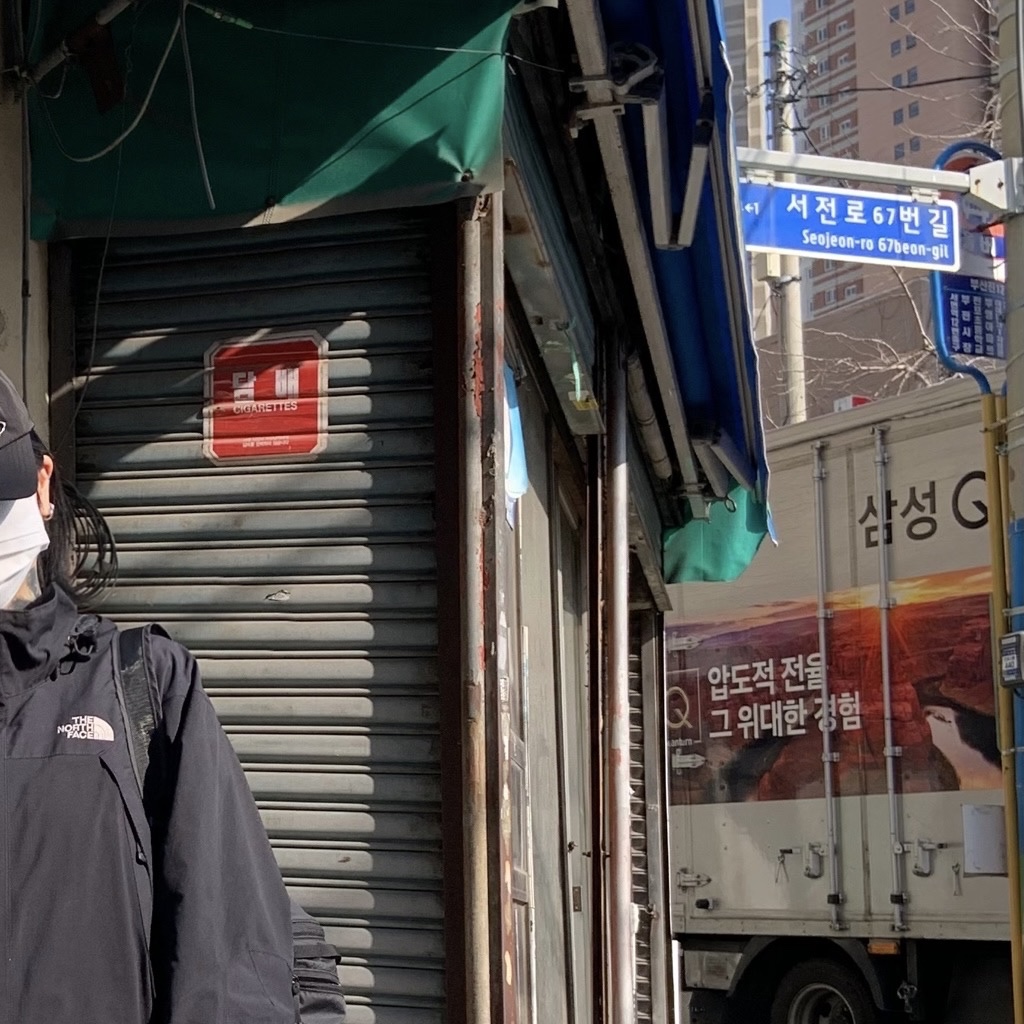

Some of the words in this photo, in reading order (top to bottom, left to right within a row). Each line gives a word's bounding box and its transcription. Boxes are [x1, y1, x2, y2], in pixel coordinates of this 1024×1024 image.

[802, 229, 874, 249] Seojeon-ro
[878, 238, 949, 260] 67beon-gil
[232, 367, 300, 404] 담배
[233, 401, 298, 414] CIGARETTES
[858, 481, 938, 549] 삼성
[708, 658, 775, 701] 압도적
[57, 723, 94, 734] NORTH
[71, 715, 94, 724] THE
[709, 709, 733, 738] 그
[737, 698, 808, 739] 위대한
[814, 691, 862, 732] 경험
[67, 731, 94, 739] FACE
